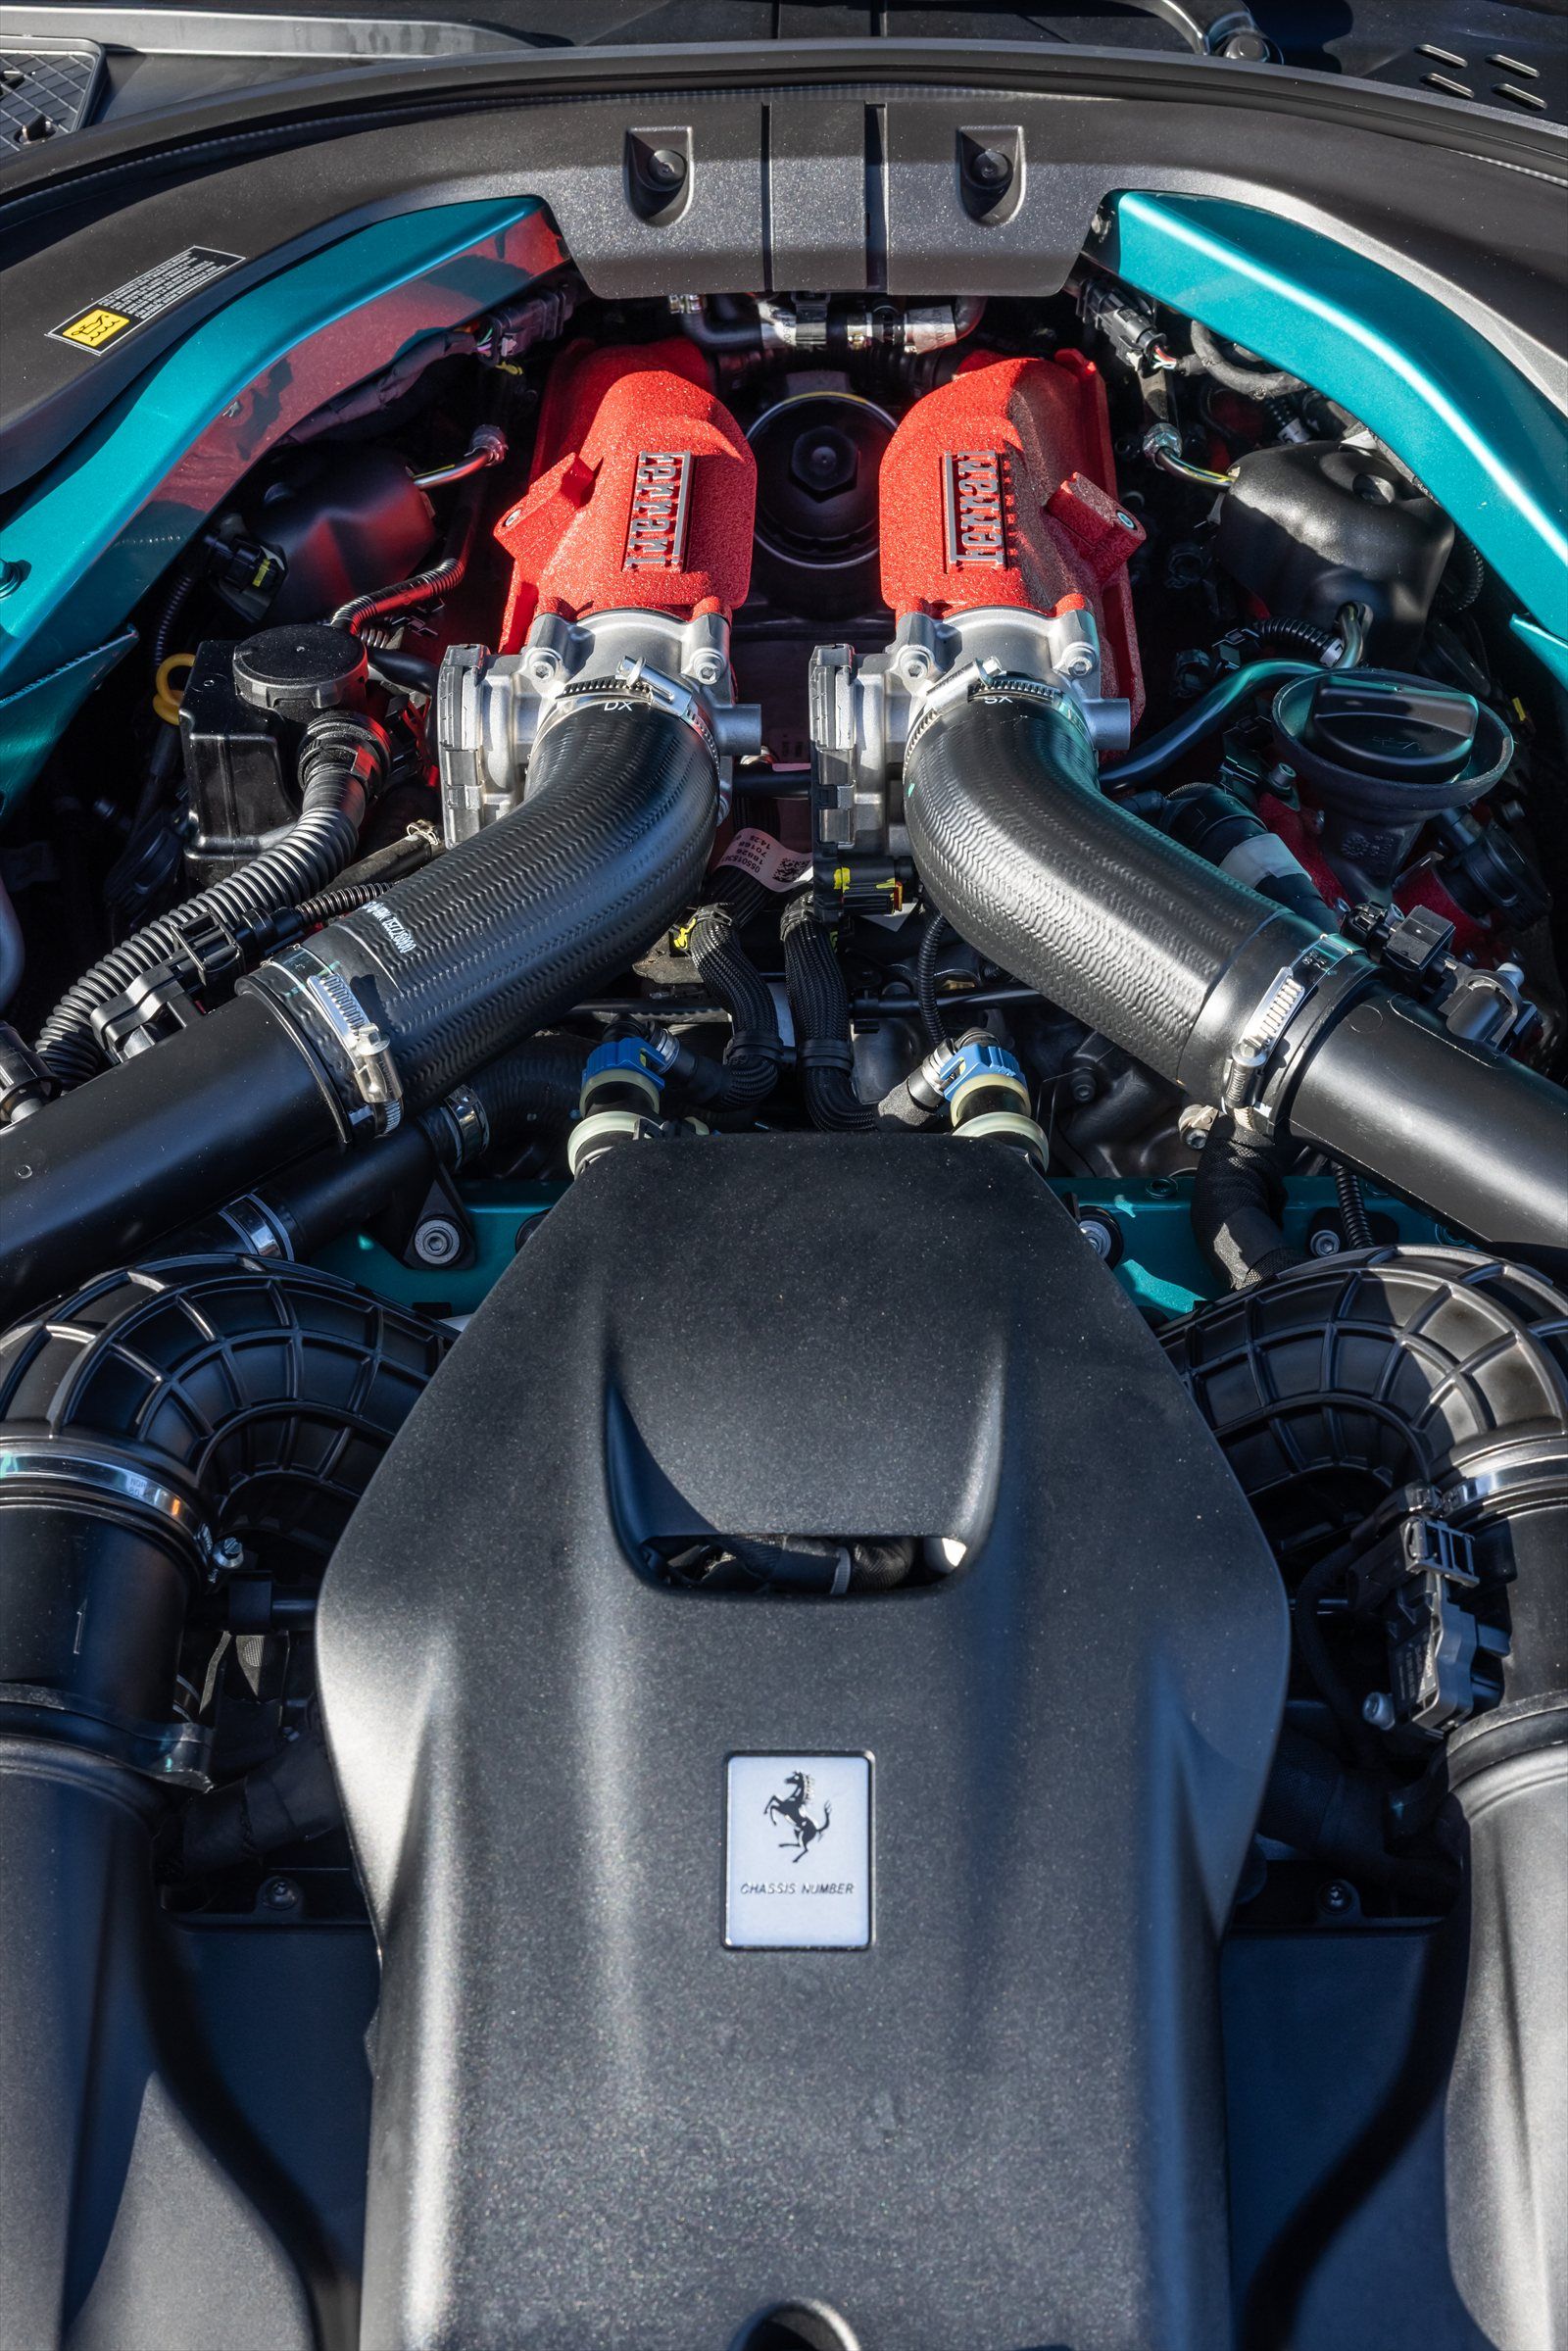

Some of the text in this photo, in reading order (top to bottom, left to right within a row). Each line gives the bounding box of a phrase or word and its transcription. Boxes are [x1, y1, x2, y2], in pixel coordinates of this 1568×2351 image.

[604, 701, 633, 711] DX
[740, 1883, 855, 1894] CHASSIS NUMBER
